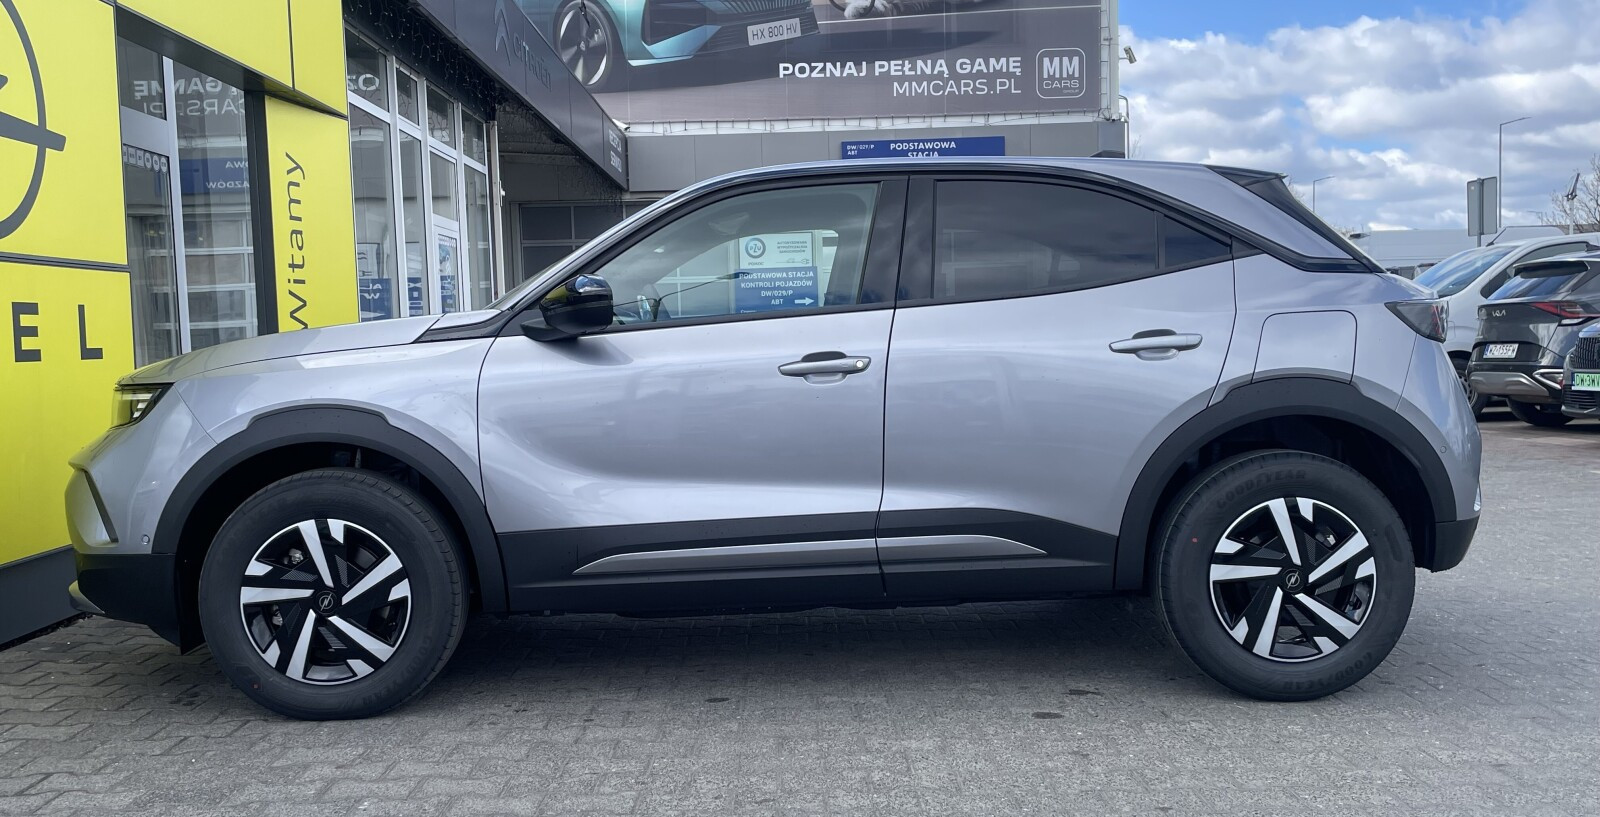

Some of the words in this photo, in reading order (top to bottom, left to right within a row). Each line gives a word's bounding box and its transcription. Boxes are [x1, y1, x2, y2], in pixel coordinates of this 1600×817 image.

[751, 28, 766, 40] HX
[767, 24, 784, 38] 800
[786, 22, 797, 35] HV
[778, 61, 866, 78] POZNAJ
[874, 59, 949, 78] PEŁNĄ
[956, 57, 1022, 76] GAMĘ
[1043, 56, 1079, 79] MM
[893, 78, 1022, 97] MMCARS.PL
[1043, 80, 1079, 88] CARS
[890, 141, 957, 150] PODSTAWOWA
[285, 152, 309, 330] Witamy
[749, 243, 762, 253] PZU
[739, 272, 787, 280] PODSTAWOWA
[741, 281, 774, 289] KONTROLI
[775, 279, 813, 288] POJAZDÓW
[1217, 469, 1307, 510] GOODYEAR
